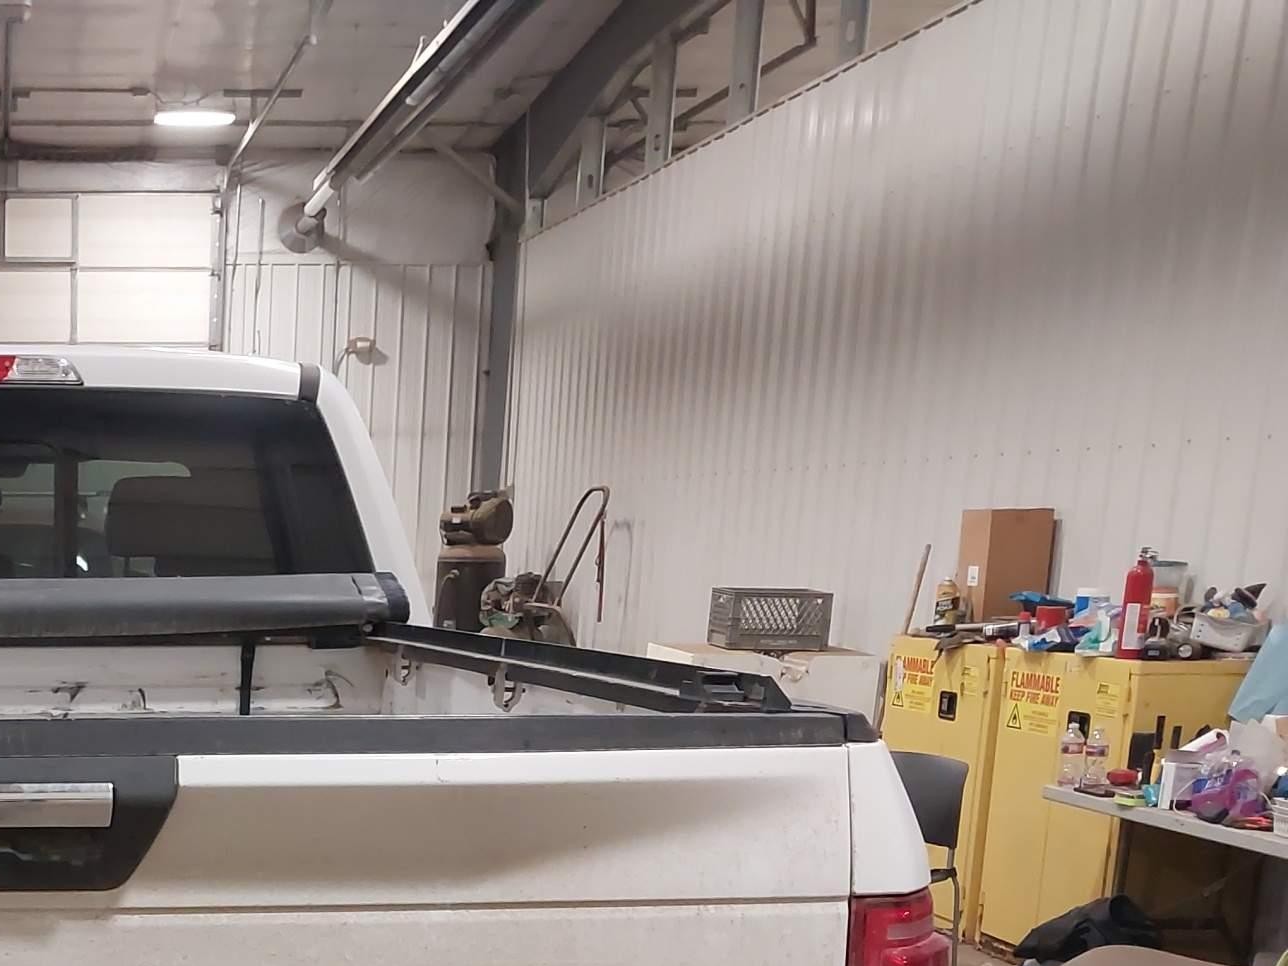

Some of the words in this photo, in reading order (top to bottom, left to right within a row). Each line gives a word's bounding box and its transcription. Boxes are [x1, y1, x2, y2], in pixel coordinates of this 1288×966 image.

[1011, 671, 1060, 694] FLAMMABLE
[1010, 689, 1026, 702] KEEP
[1025, 691, 1041, 705] FIRE
[1041, 694, 1059, 708] AWAY
